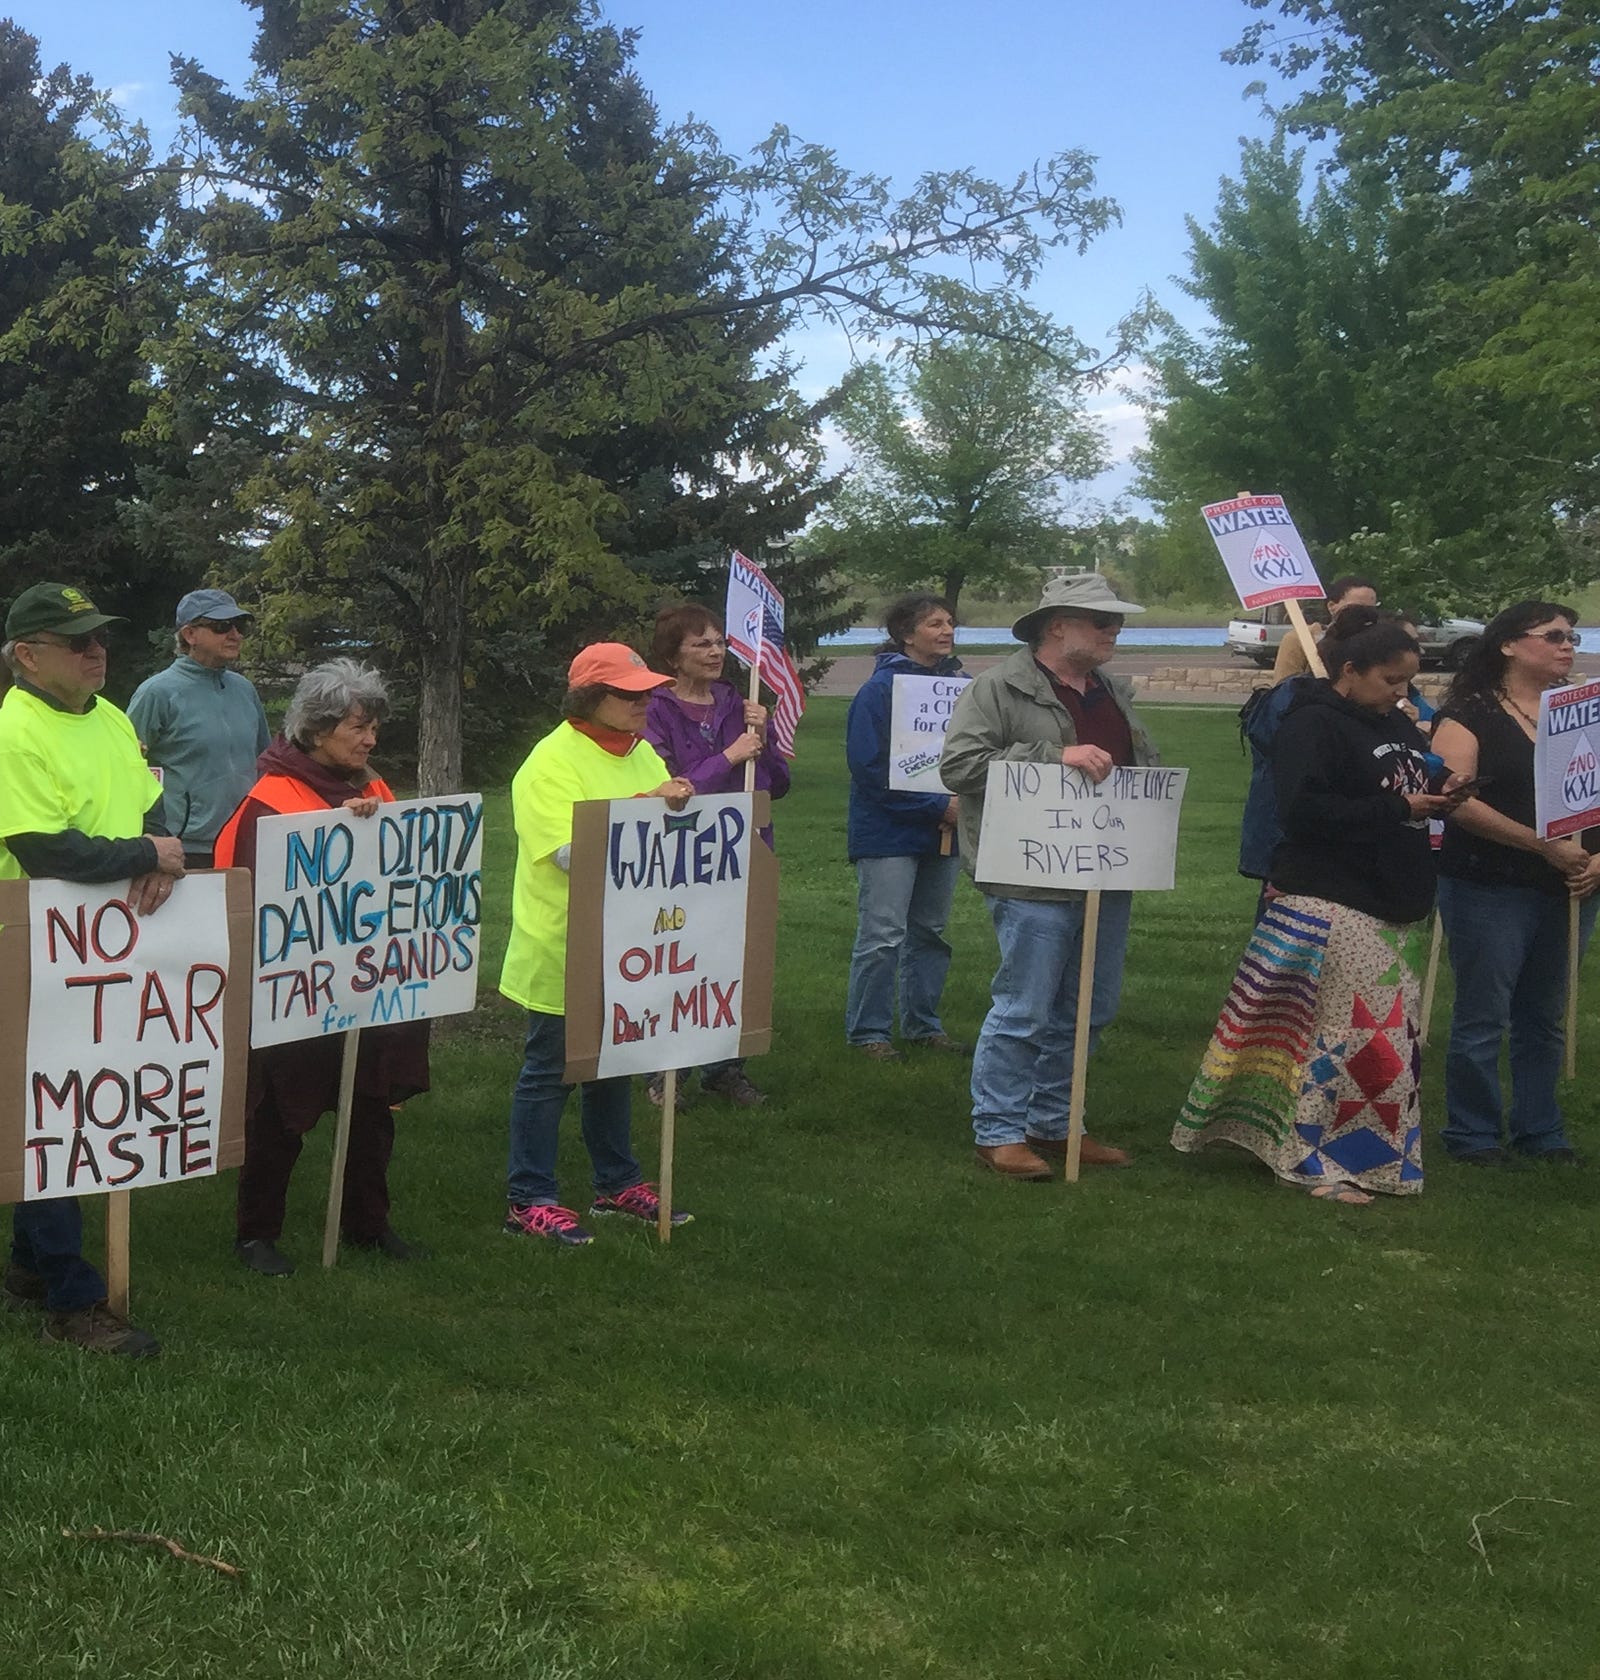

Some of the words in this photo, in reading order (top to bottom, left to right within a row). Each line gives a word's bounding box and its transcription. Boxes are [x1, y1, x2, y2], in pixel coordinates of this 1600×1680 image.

[1206, 498, 1258, 515] PROTECT
[1210, 507, 1291, 535] WATER
[1253, 543, 1291, 561] #NO
[1254, 558, 1303, 580] KXL
[735, 562, 784, 623] WATER
[932, 681, 963, 696] Cre
[913, 717, 937, 732] for
[920, 703, 928, 713] a
[1549, 698, 1600, 734] WATE
[898, 752, 926, 769] CLEAN
[905, 753, 941, 775] ENERGY
[1567, 752, 1596, 777] #NO
[1005, 762, 1041, 800] NO
[1113, 767, 1180, 800] PIPELINE
[1565, 771, 1599, 803] KXL
[285, 823, 354, 891] NO
[379, 801, 483, 876] DIRTY
[610, 806, 745, 890] WATER
[1018, 838, 1129, 874] RIVERS
[46, 899, 139, 964] NO
[259, 870, 482, 968] DANGEROUS
[653, 904, 686, 936] AND
[259, 960, 336, 1022] TAR
[351, 926, 476, 992] SANDS
[619, 940, 697, 982] OIL
[65, 963, 228, 1050] TAR
[321, 1004, 356, 1033] for
[371, 981, 429, 1023] MT.
[32, 1059, 210, 1130] MORE
[25, 1120, 212, 1193] TASTE
